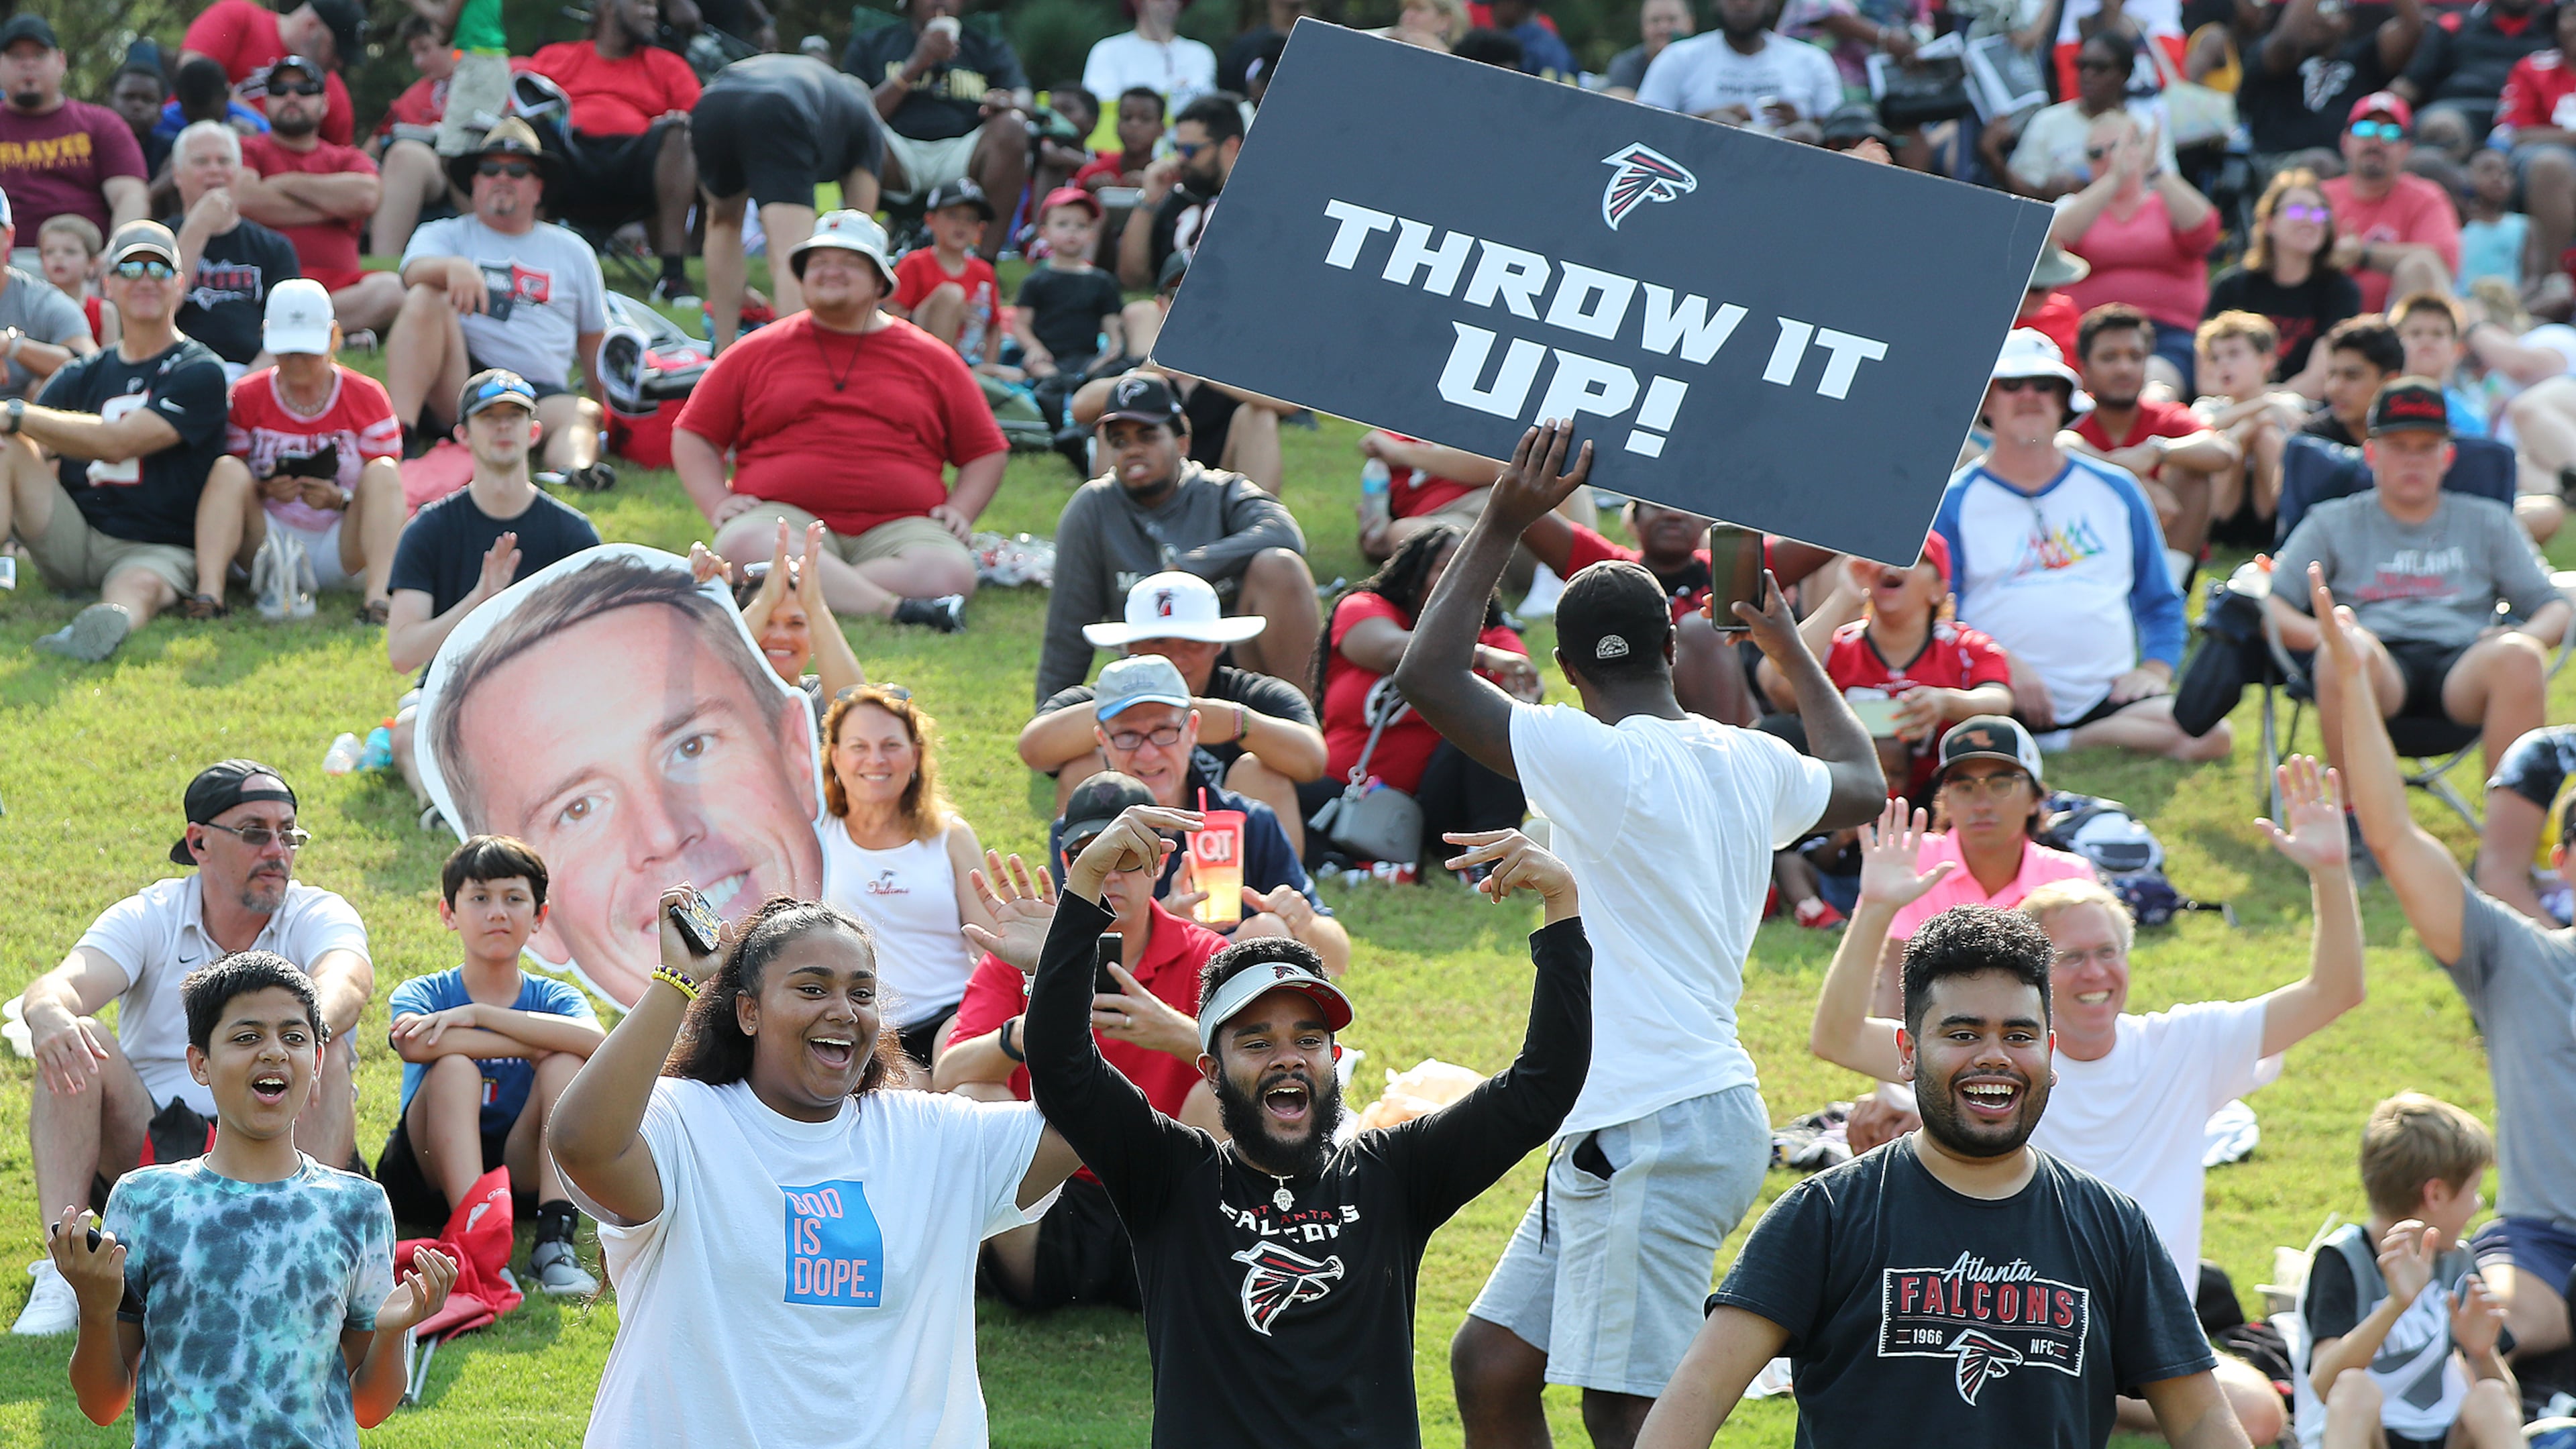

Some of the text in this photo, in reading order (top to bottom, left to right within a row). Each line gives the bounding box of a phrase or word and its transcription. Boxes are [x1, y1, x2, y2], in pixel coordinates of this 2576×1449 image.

[1324, 199, 1889, 400] THROW IT
[1437, 320, 1689, 458] UP!
[1196, 830, 1234, 861] QT
[786, 1187, 843, 1218] GOD
[1250, 1205, 1333, 1224] ATANTA
[794, 1218, 822, 1256] IS
[794, 1257, 874, 1298] DOPE.
[1941, 1250, 2037, 1286] Atlanta
[1900, 1276, 2074, 1328] FALCONS
[1913, 1328, 2055, 1356] 1966 NFC
